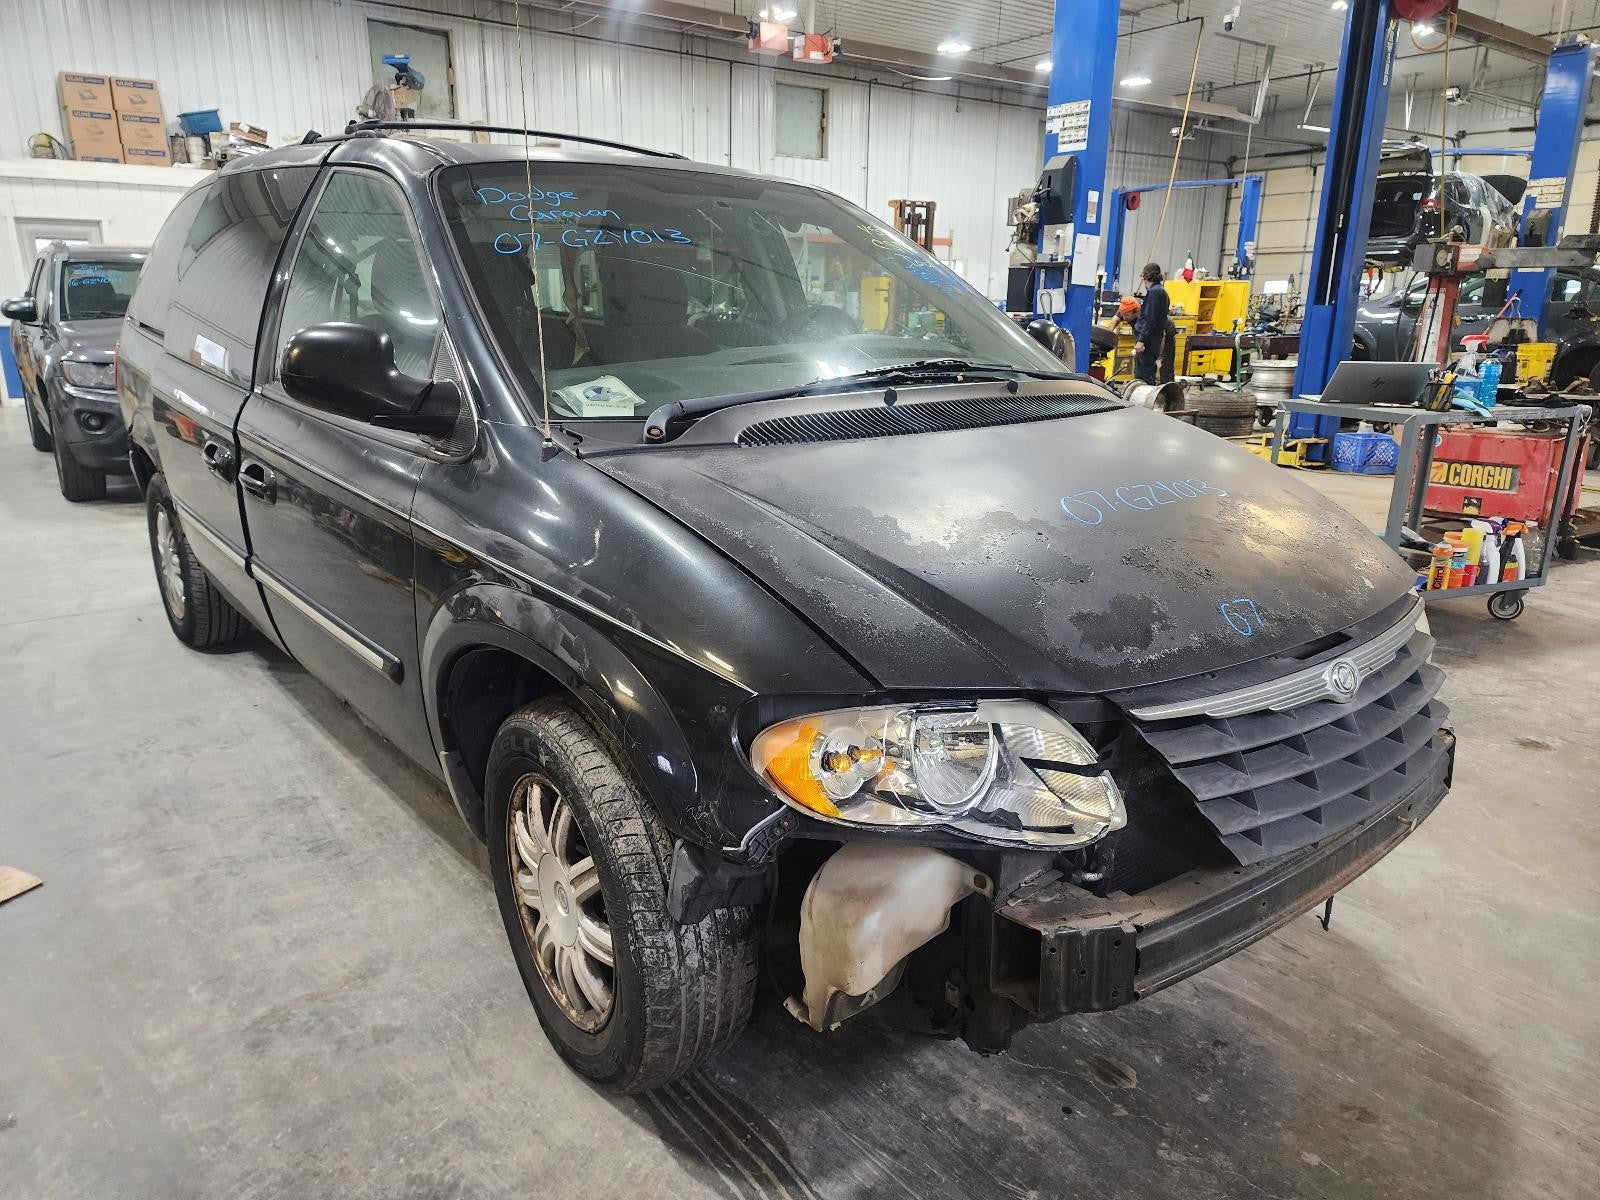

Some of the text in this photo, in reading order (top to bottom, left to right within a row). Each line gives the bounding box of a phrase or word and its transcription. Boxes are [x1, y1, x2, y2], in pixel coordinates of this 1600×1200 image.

[476, 186, 580, 207] Dodge
[509, 204, 623, 222] Caravan
[1448, 462, 1513, 490] CORGHI
